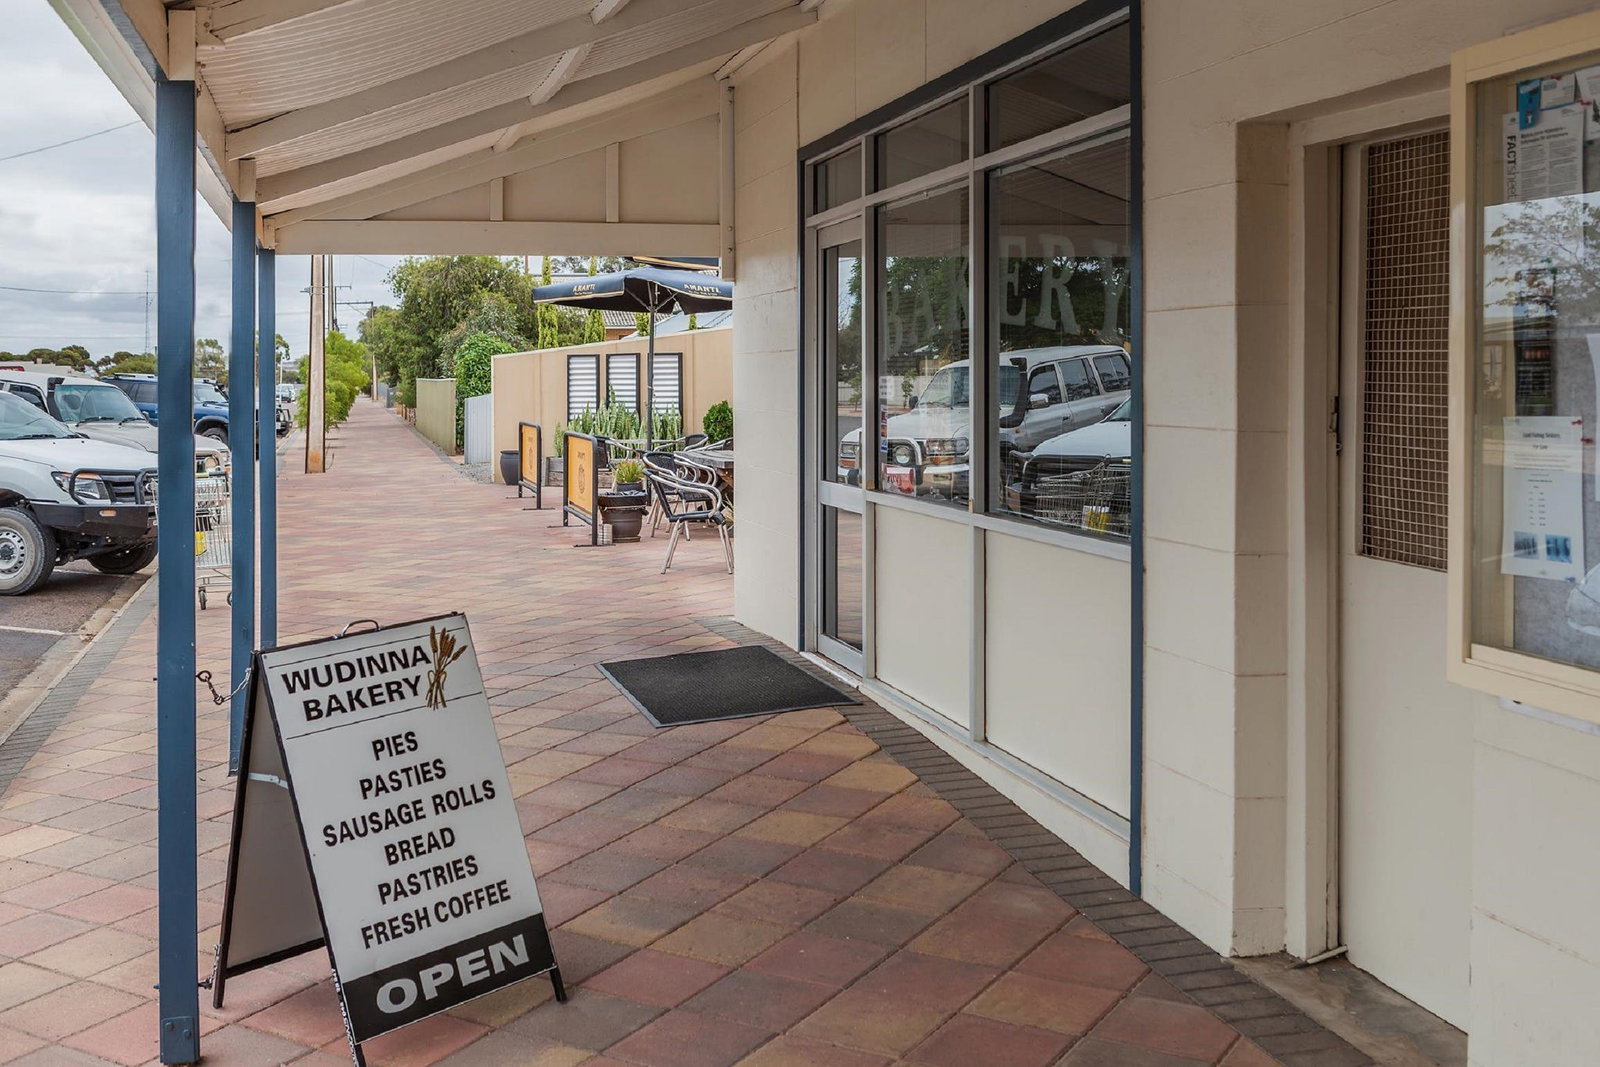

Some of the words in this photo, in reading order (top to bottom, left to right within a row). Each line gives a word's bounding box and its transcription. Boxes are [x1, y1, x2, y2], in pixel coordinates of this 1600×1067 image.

[281, 644, 431, 695] WUDINNA
[303, 675, 422, 722] BAKERY
[371, 731, 418, 761] PIES
[359, 758, 447, 800] PASTIES
[322, 800, 426, 847] SAUSAGE
[434, 779, 496, 815] ROLLS
[384, 827, 455, 866] BREAD
[377, 855, 479, 905] PASTRIES
[361, 914, 431, 949] FRESH
[434, 880, 511, 923] COFFEE
[376, 933, 530, 1014] OPEN
